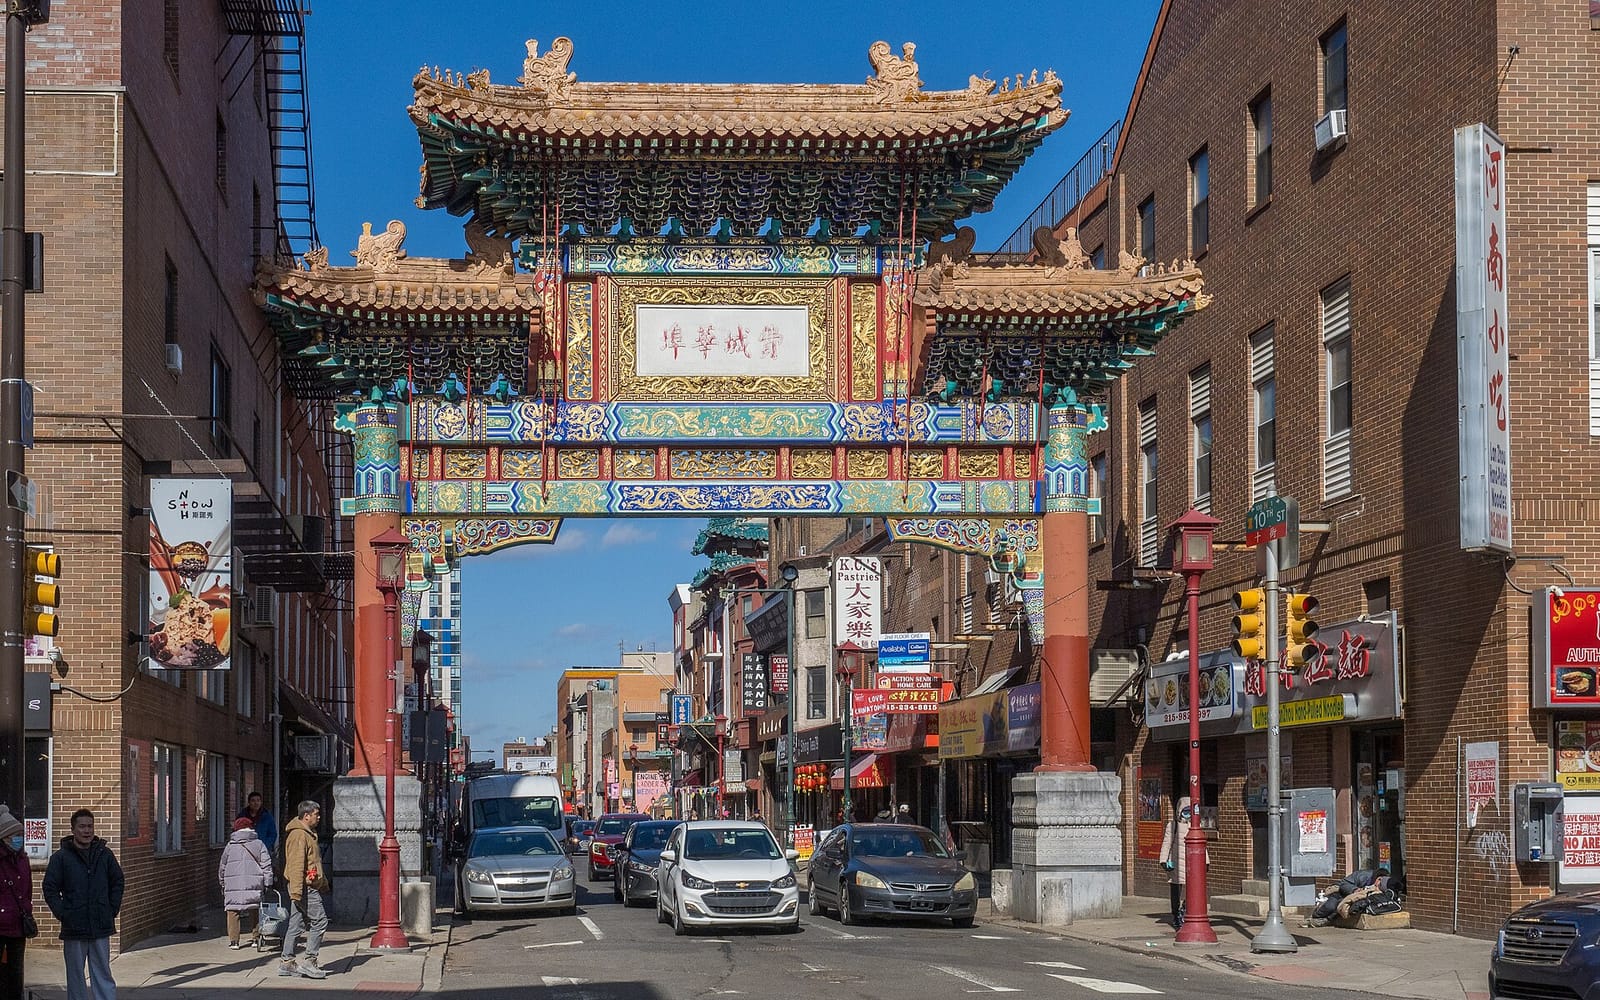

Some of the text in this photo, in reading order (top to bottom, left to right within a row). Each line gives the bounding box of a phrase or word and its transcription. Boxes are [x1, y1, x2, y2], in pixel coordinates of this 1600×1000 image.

[1485, 143, 1507, 431] 河南小吃
[1276, 509, 1286, 522] ST
[837, 572, 880, 581] Pastries
[845, 582, 873, 638] 大家樂
[880, 645, 907, 653] Available
[1566, 647, 1600, 662] AUTH
[755, 655, 765, 708] PENANG
[867, 694, 884, 703] LOVE
[1323, 697, 1344, 719] Noodles
[858, 777, 872, 787] SIU
[1469, 781, 1496, 794] NO ARENA
[1563, 837, 1600, 849] NO ARE
